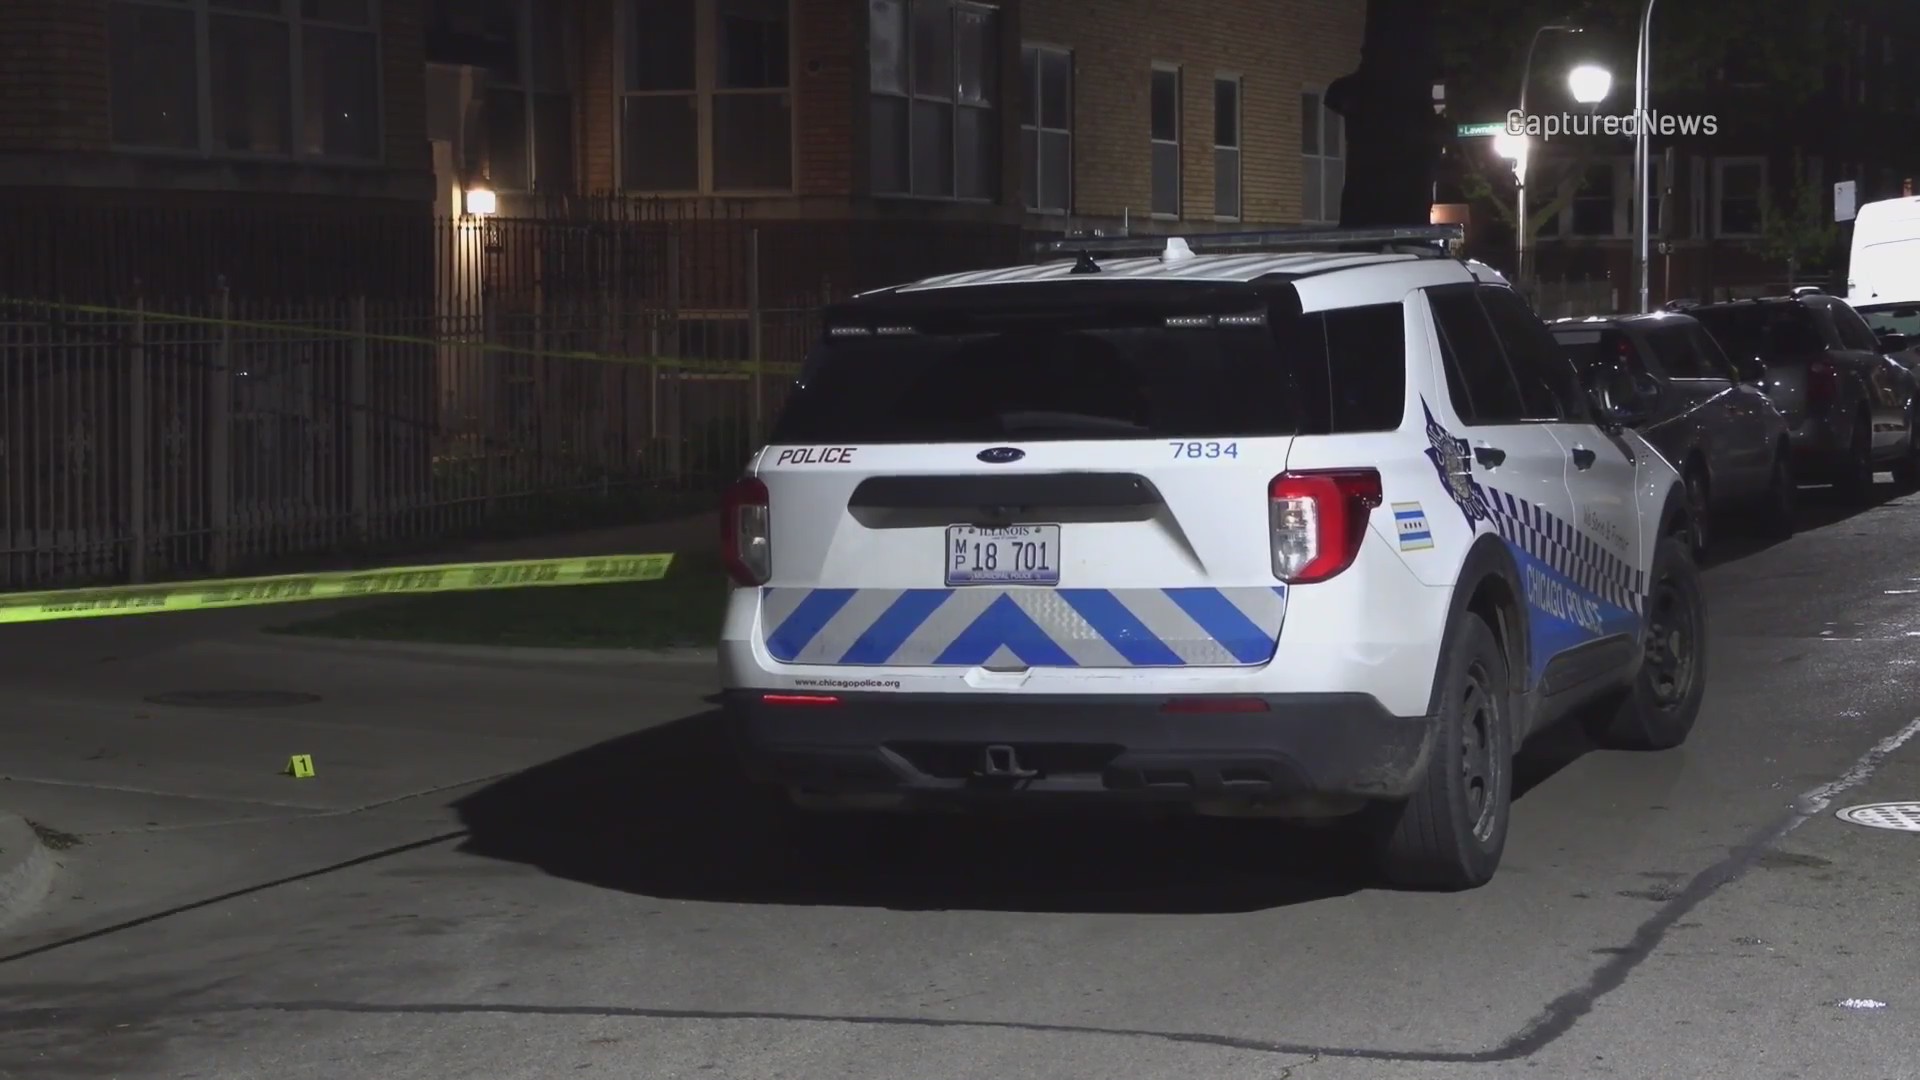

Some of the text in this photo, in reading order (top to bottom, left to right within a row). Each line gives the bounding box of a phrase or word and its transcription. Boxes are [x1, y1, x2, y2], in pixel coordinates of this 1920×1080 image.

[777, 447, 857, 466] POLICE
[1169, 442, 1238, 459] 7834
[980, 527, 1030, 537] ILLINOIS
[972, 541, 1050, 571] 18 701
[1526, 564, 1566, 620] CHICAGO
[795, 679, 900, 689] www.chicagopolice.org
[299, 757, 308, 772] 1
